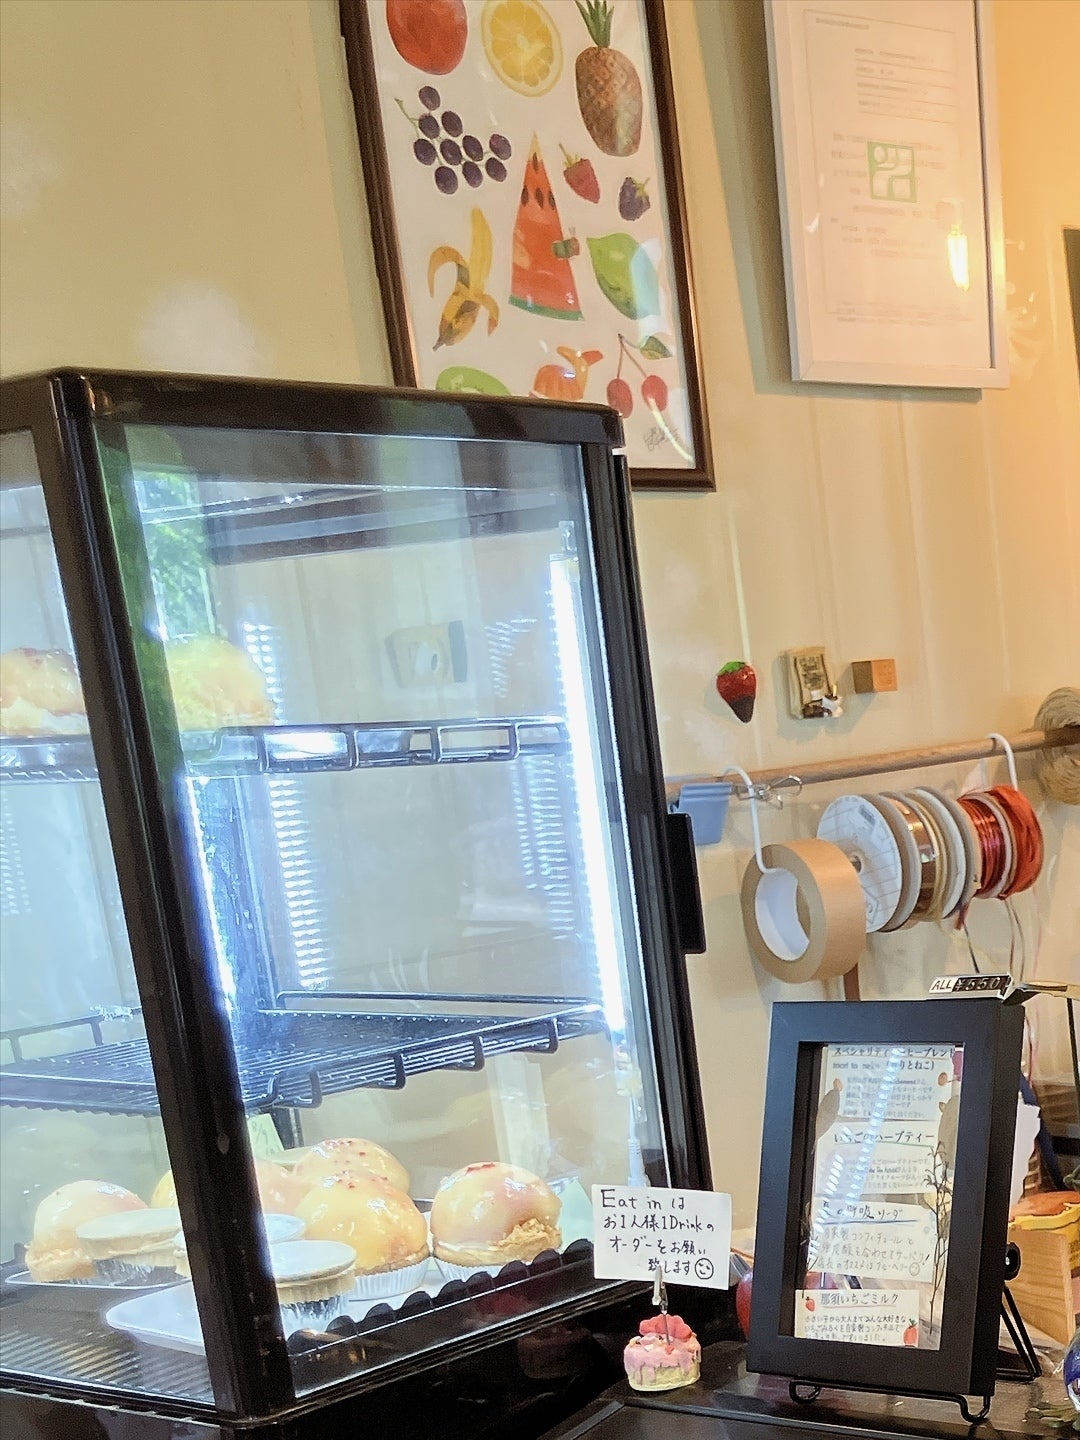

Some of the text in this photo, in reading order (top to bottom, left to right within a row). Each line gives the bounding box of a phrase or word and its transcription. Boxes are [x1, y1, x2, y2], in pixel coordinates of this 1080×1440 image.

[932, 979, 952, 990] ALL
[601, 1188, 685, 1210] Eat in は
